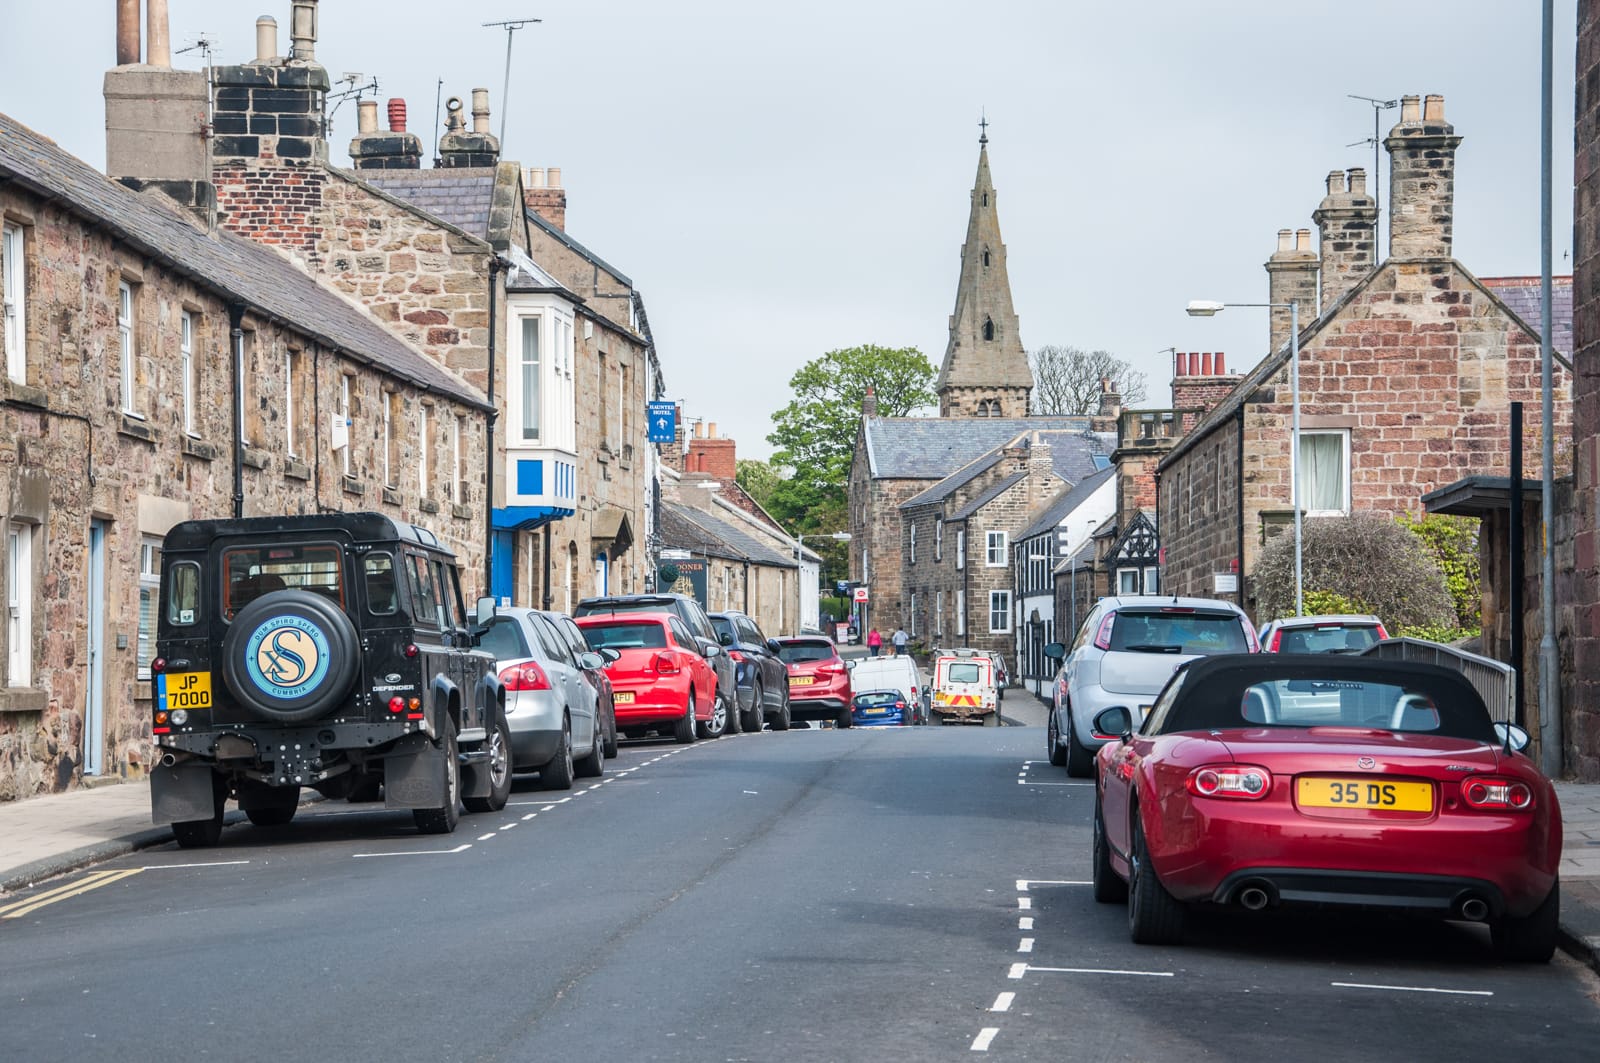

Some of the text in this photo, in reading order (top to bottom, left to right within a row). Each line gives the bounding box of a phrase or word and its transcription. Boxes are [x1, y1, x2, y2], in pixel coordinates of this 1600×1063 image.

[254, 618, 319, 640] DUM SPIRO SPERO
[179, 675, 198, 690] JP
[372, 684, 415, 692] DEFENDER
[168, 690, 210, 707] 7000
[271, 686, 307, 696] CUMBRIA
[1330, 782, 1396, 805] 35 DS
